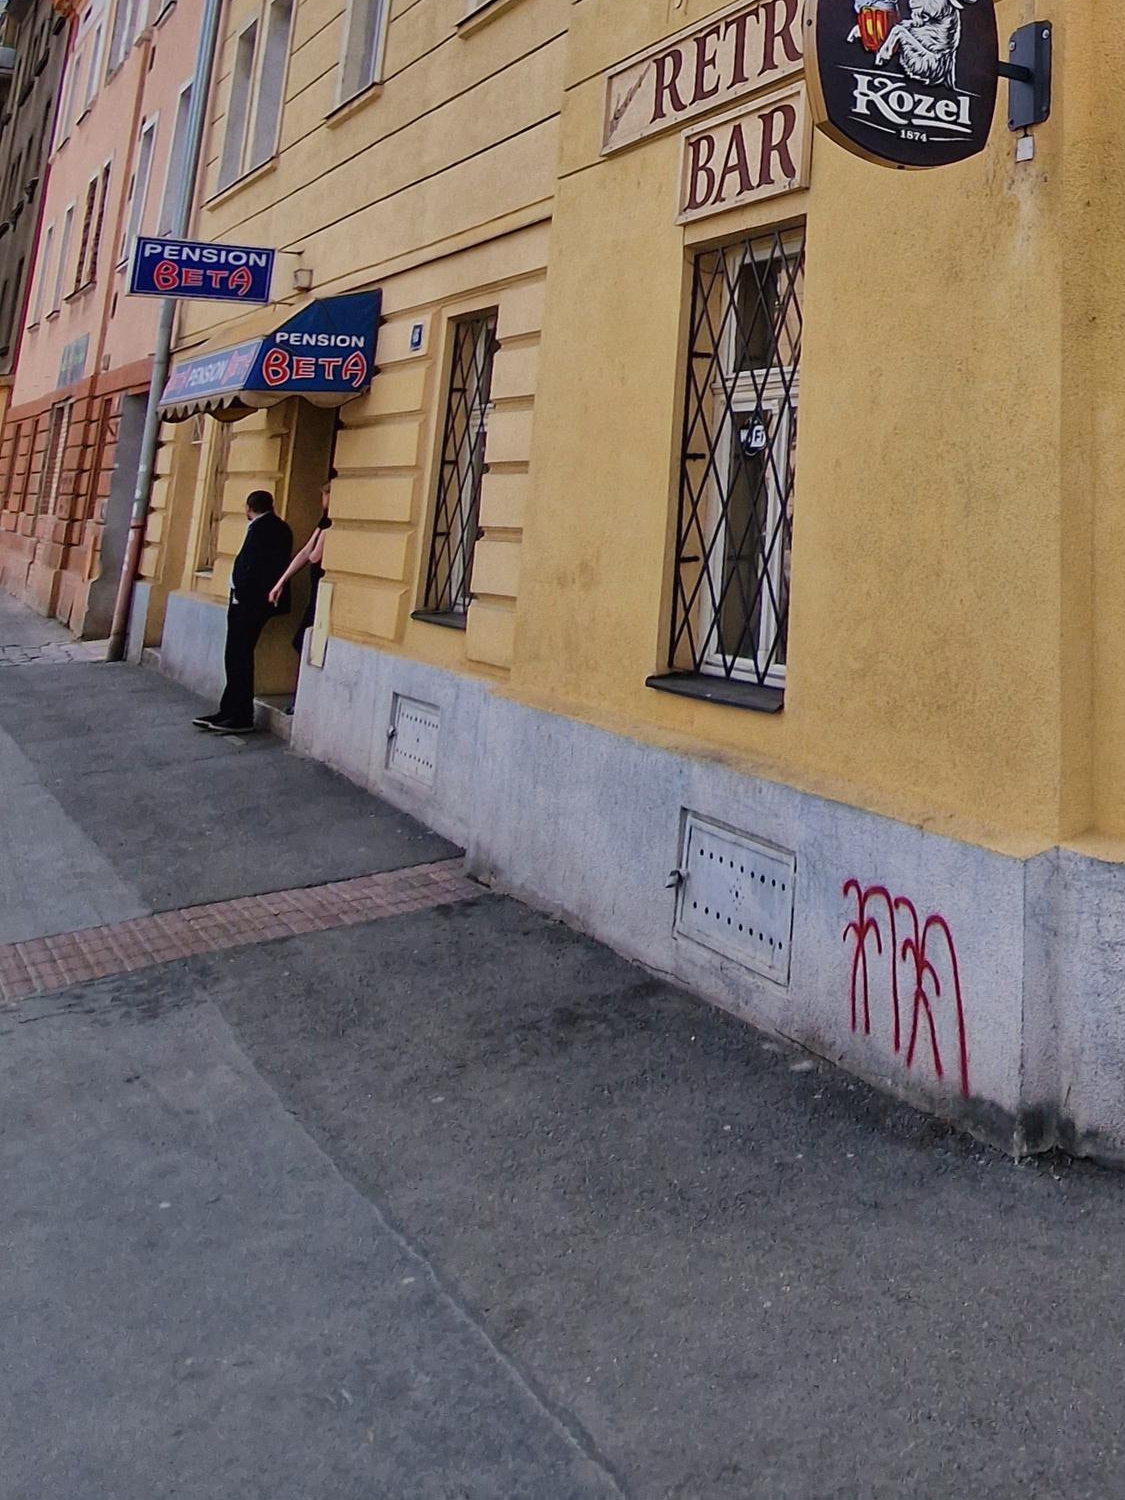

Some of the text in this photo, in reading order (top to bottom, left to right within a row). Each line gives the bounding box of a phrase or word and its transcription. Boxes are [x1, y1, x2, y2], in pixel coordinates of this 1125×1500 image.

[852, 74, 972, 125] Kozel
[900, 129, 928, 143] 1874
[682, 103, 797, 212] BAR
[144, 243, 267, 267] PENSION
[153, 259, 253, 297] BETA
[275, 332, 365, 348] PENSION
[262, 348, 367, 388] BETA
